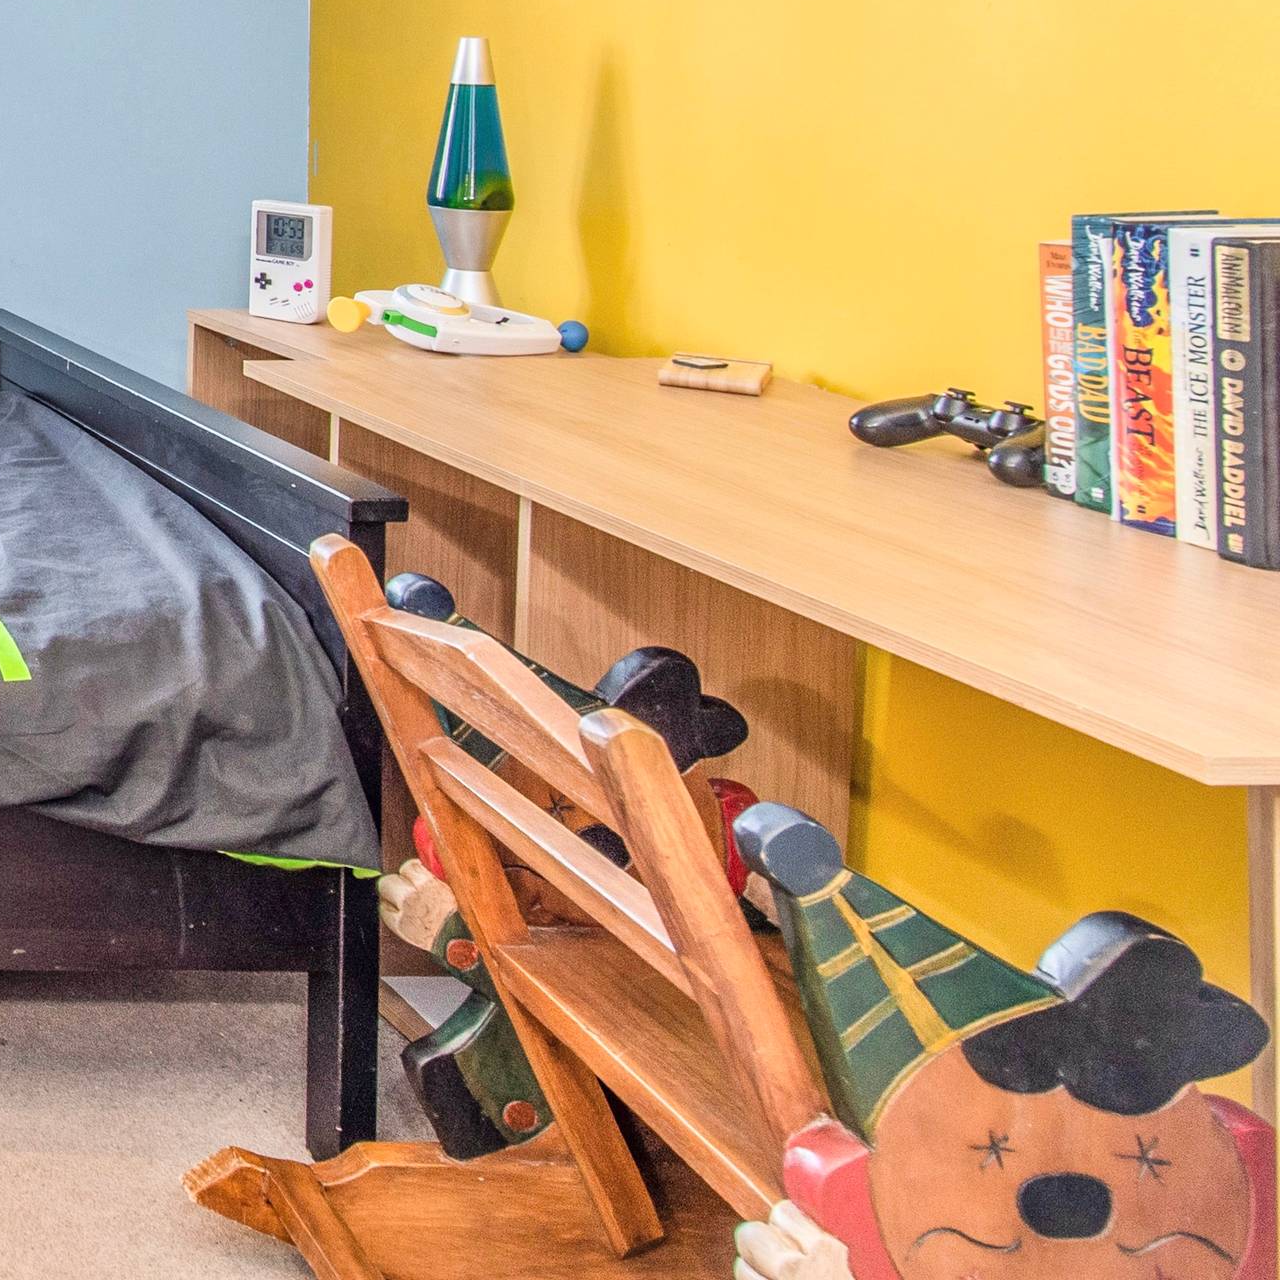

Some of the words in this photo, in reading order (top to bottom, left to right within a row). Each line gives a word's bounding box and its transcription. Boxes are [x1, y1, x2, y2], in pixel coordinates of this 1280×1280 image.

[1085, 225, 1103, 263] David
[1125, 231, 1145, 272] David
[1045, 275, 1073, 327] WHO
[1187, 276, 1208, 365] MONSTER
[1077, 321, 1106, 370] BAD
[1047, 354, 1075, 413] GODS
[1077, 373, 1110, 424] DAD
[1122, 344, 1155, 447] BEAST
[1189, 372, 1209, 404] ICE
[1221, 377, 1245, 437] DAVID
[1193, 408, 1208, 438] THE
[1222, 439, 1246, 528] BADDIEL
